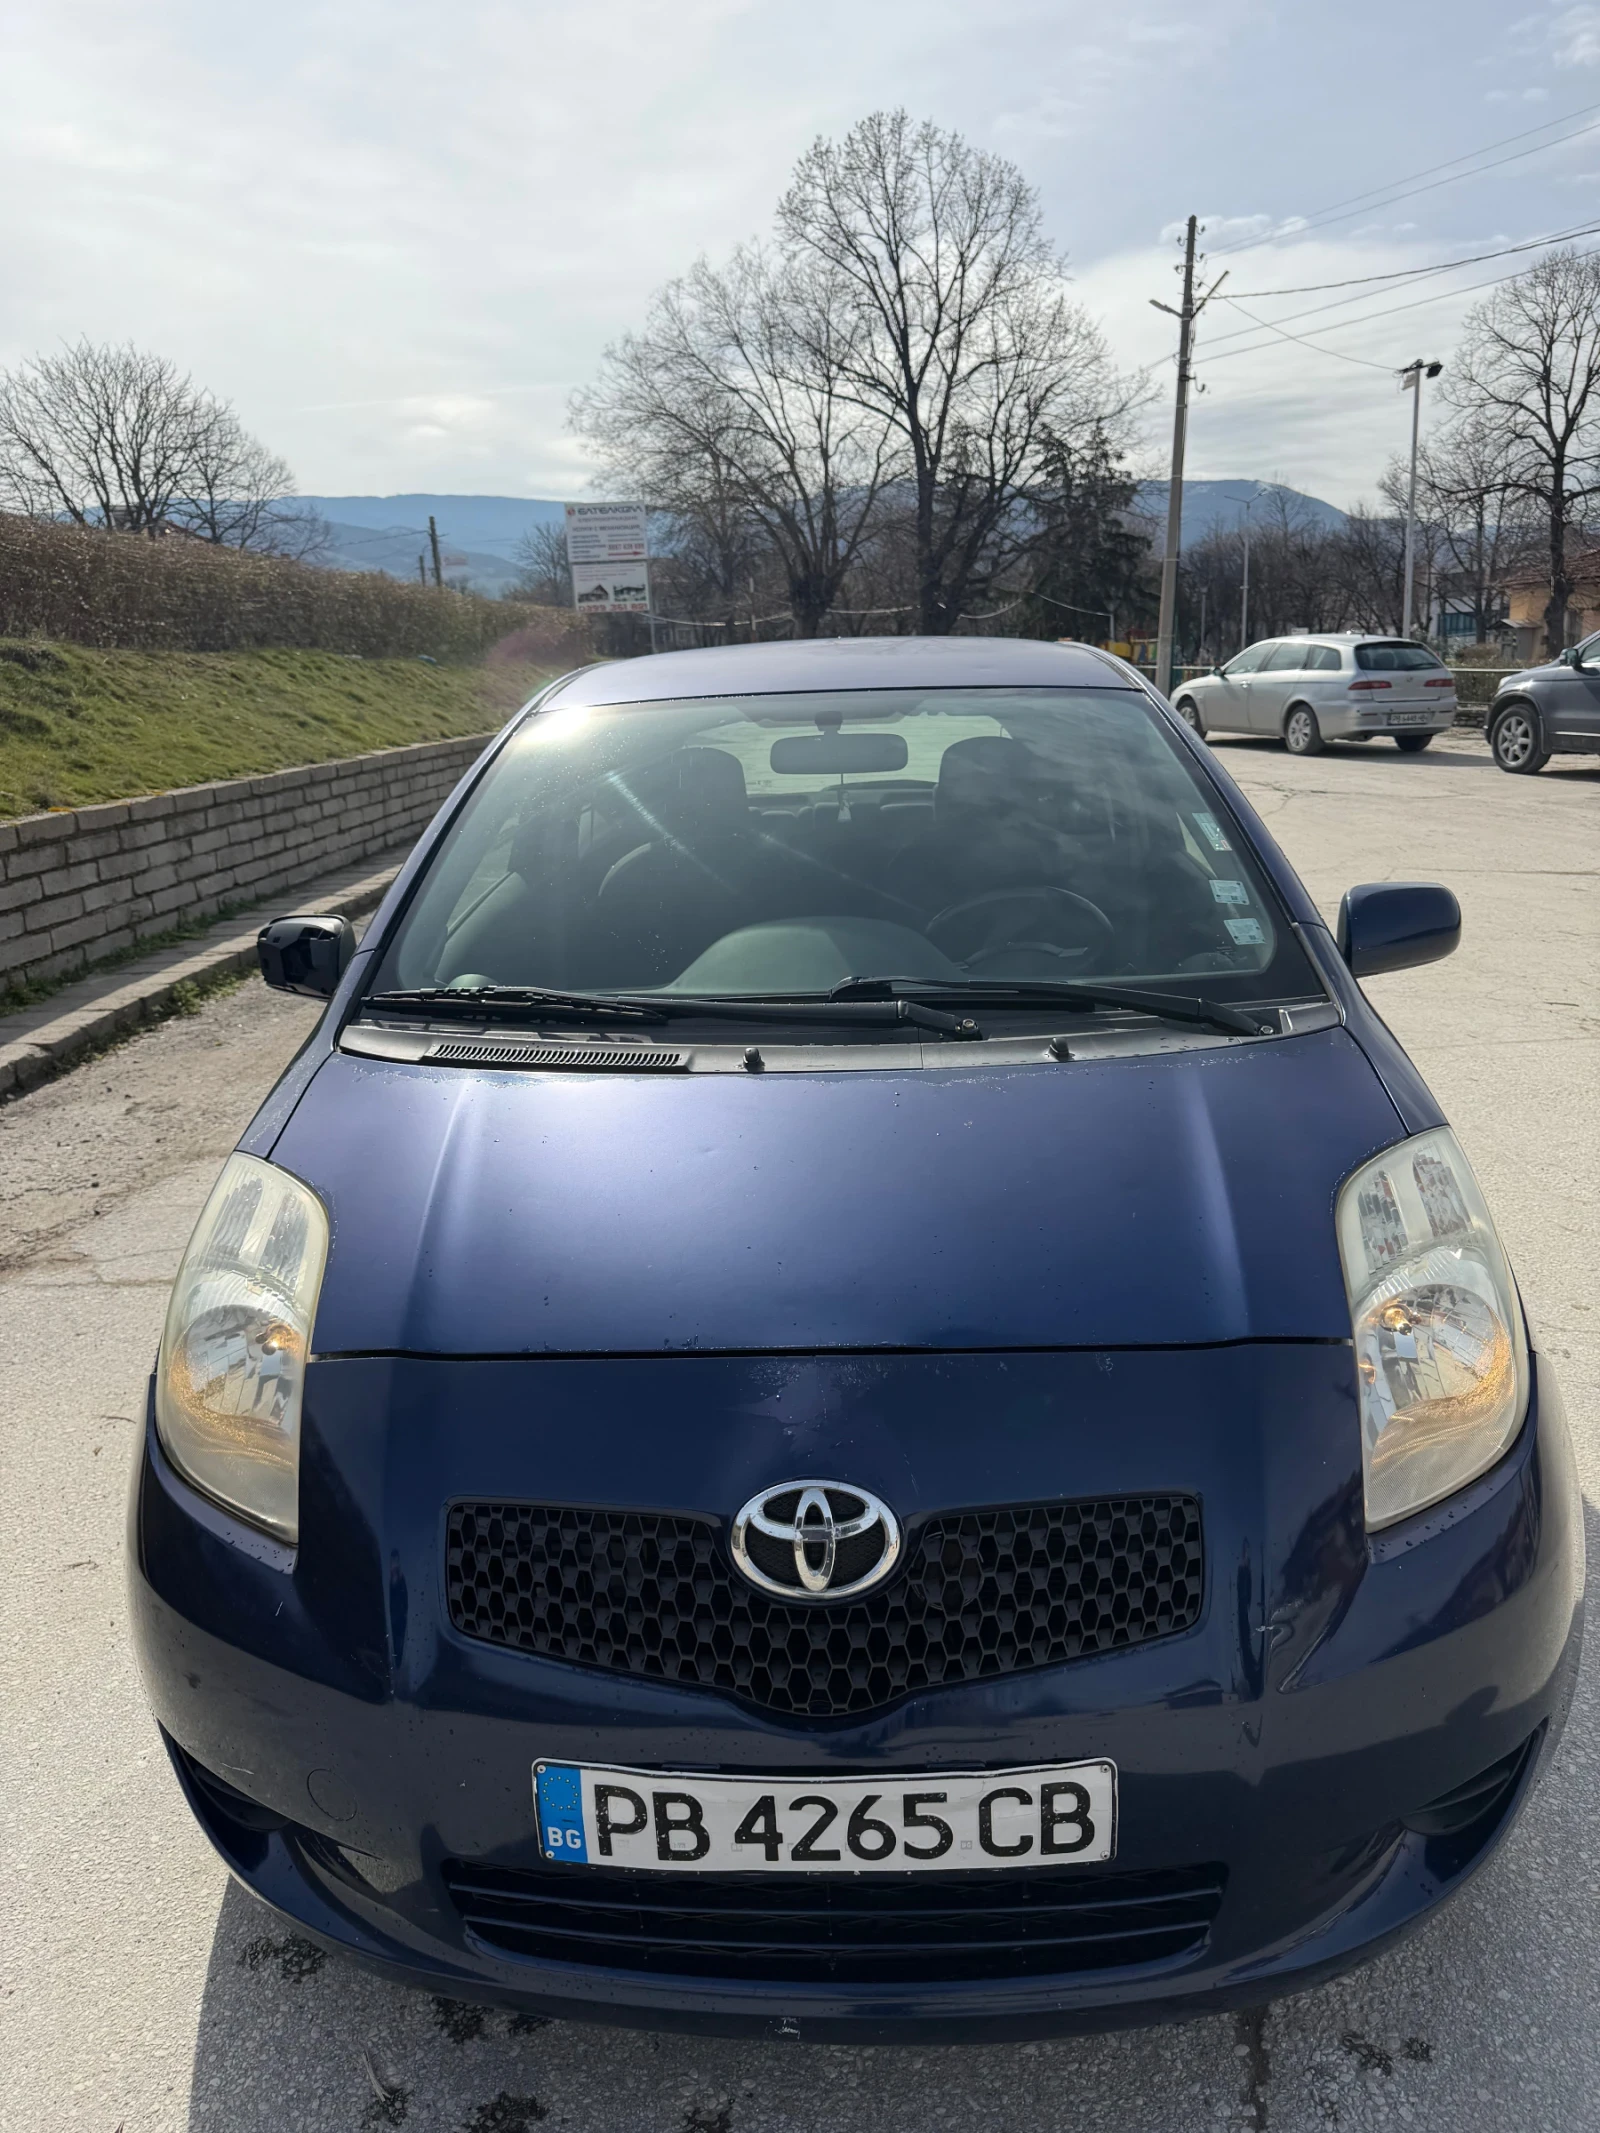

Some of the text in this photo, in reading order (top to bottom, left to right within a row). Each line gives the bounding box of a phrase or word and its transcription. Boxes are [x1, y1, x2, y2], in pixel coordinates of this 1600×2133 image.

[547, 1782, 1094, 1861] BG PB 4265 CB
